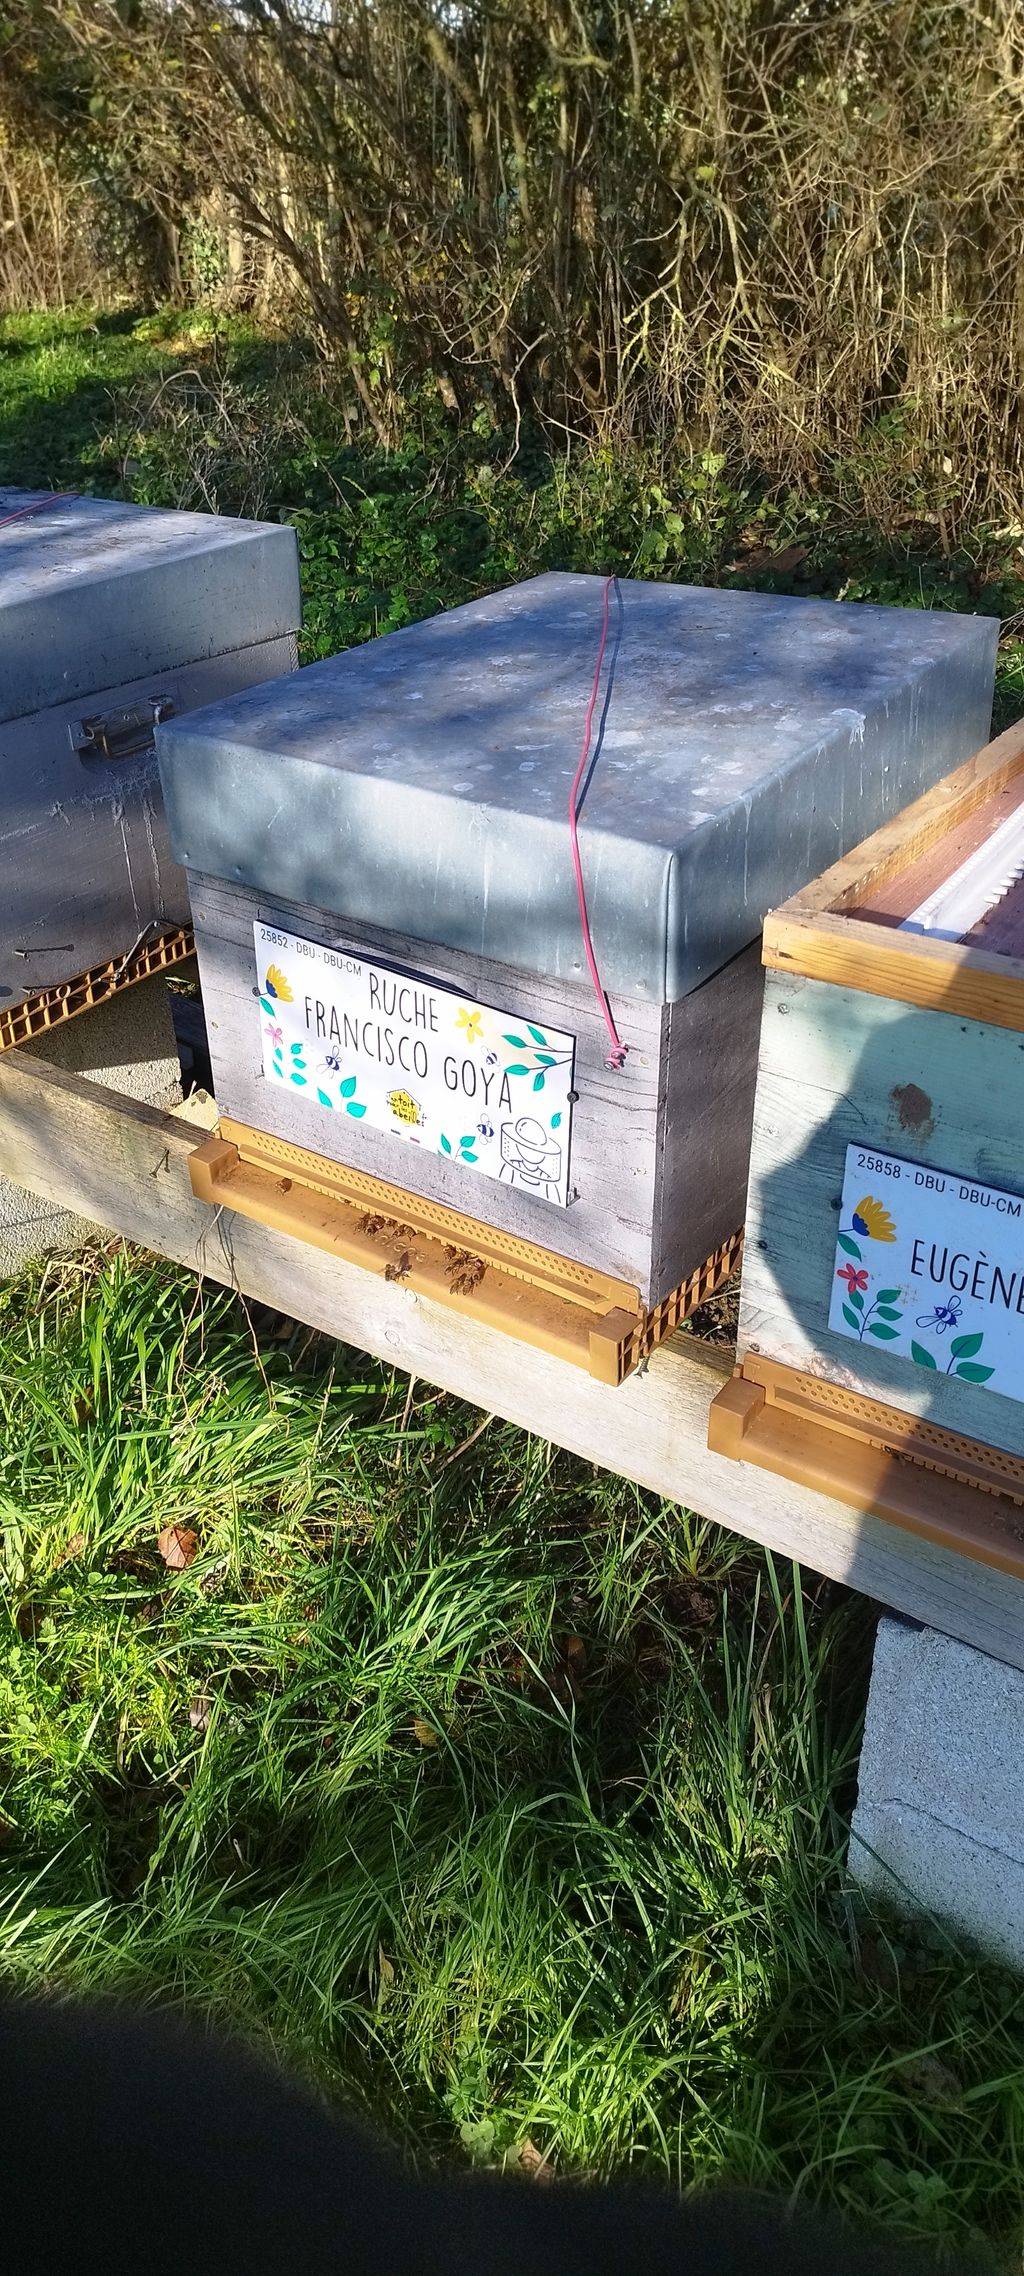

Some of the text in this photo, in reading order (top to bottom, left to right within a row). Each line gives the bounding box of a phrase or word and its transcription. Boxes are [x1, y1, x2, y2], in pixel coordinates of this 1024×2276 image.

[260, 928, 289, 949] 25852
[296, 941, 316, 959] DBU
[323, 952, 362, 977] DBU-CM
[369, 972, 439, 1032] RUCHE
[304, 996, 512, 1113] FRANCISCO GOYA
[857, 1153, 901, 1179] 25858
[914, 1172, 946, 1193] DBU
[959, 1186, 1022, 1217] DBU-CM
